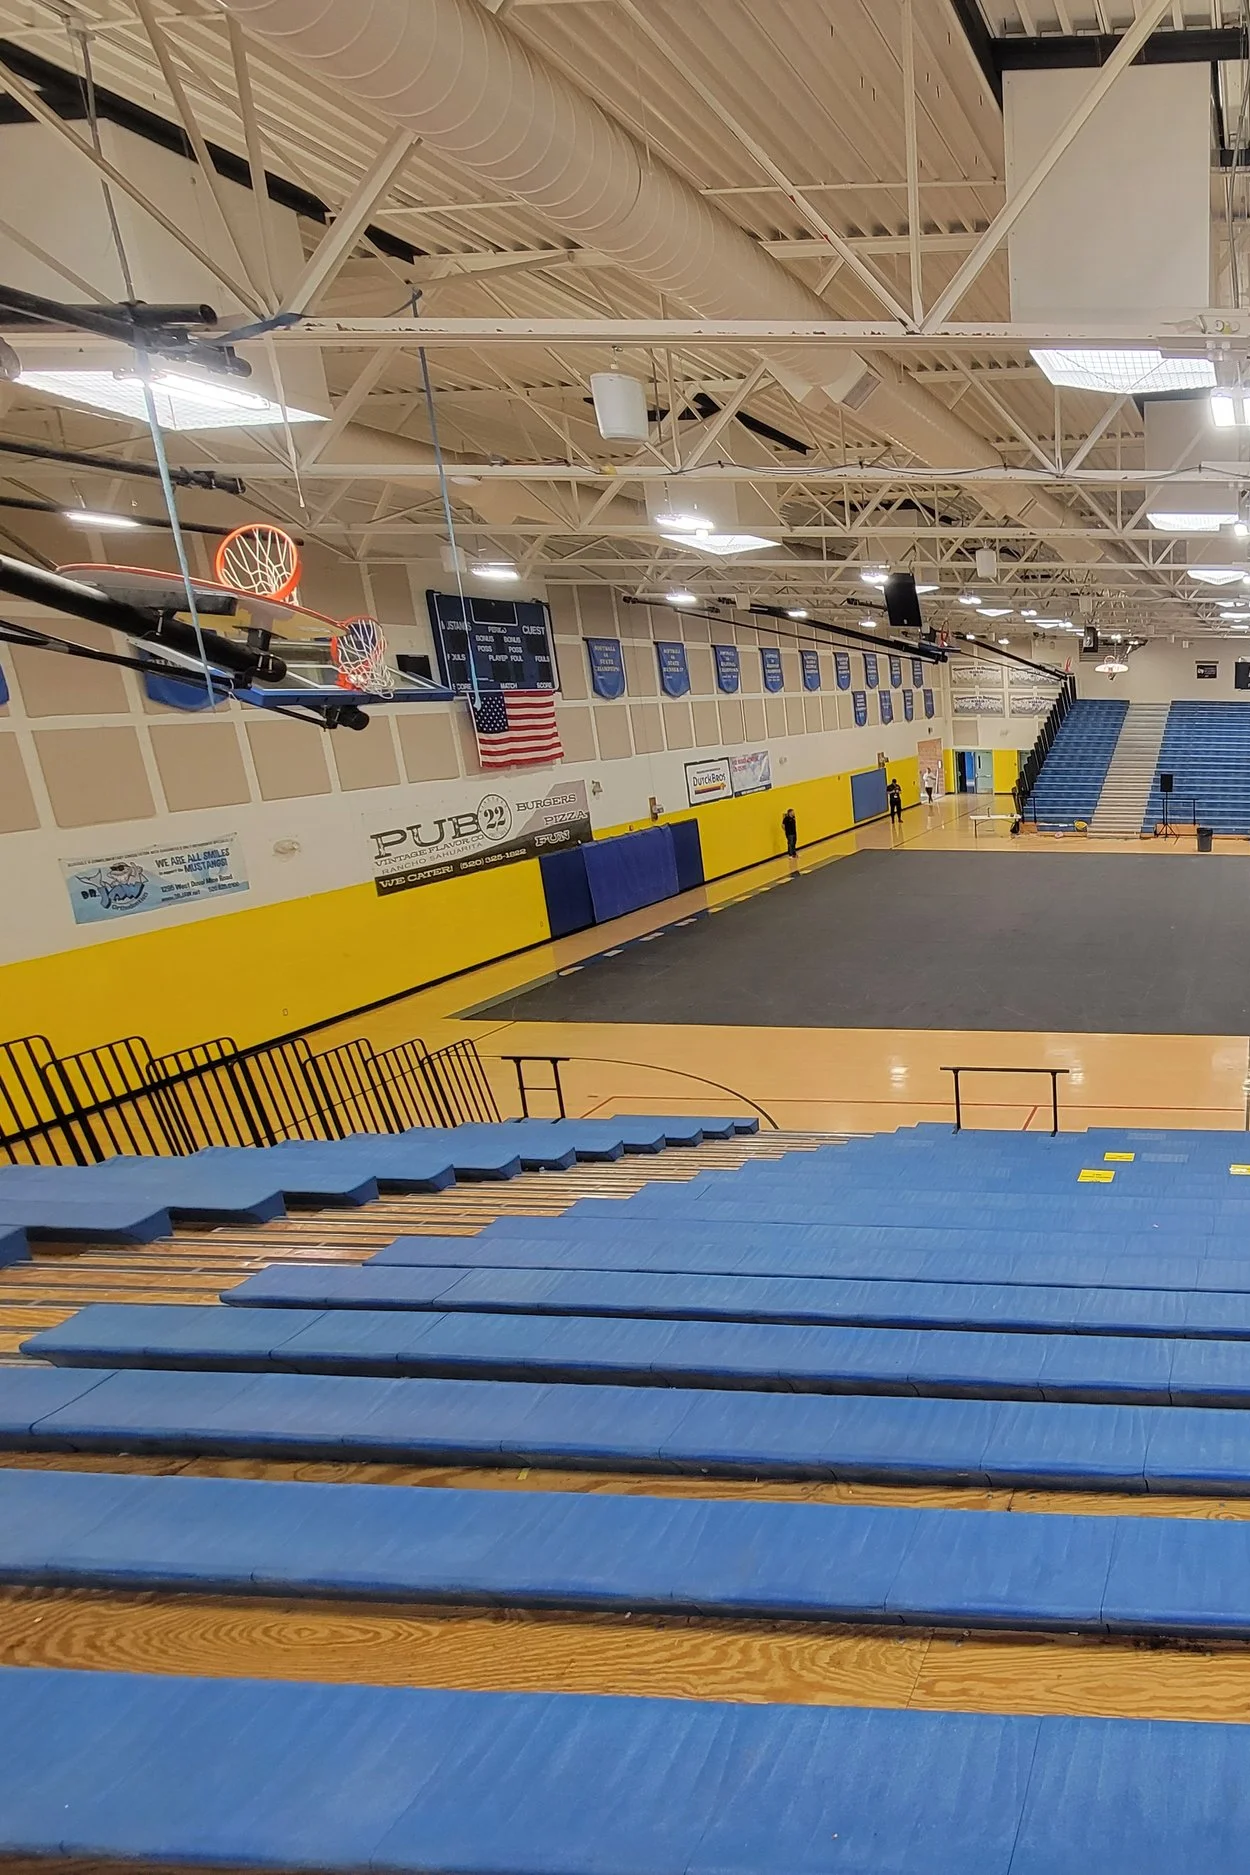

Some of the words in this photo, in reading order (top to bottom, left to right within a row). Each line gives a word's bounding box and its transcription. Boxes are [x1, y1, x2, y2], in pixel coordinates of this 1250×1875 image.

[475, 634, 494, 642] BONUS
[522, 625, 545, 635] GUEST
[515, 794, 577, 812] BURGERS
[543, 810, 589, 826] PIZZA
[369, 812, 481, 860] PUB
[483, 805, 506, 830] 22
[534, 829, 570, 847] FUN
[155, 858, 169, 868] WE
[170, 856, 187, 867] ARE
[187, 852, 202, 863] ALL
[203, 848, 230, 861] SMILES
[374, 849, 428, 867] VINTAGE
[427, 838, 471, 855] FLAVOR
[381, 857, 427, 875] RANCHO
[429, 842, 484, 862] SAHUARITA
[378, 876, 406, 889] WE
[407, 865, 454, 882] CATER!
[459, 857, 485, 870] (520)
